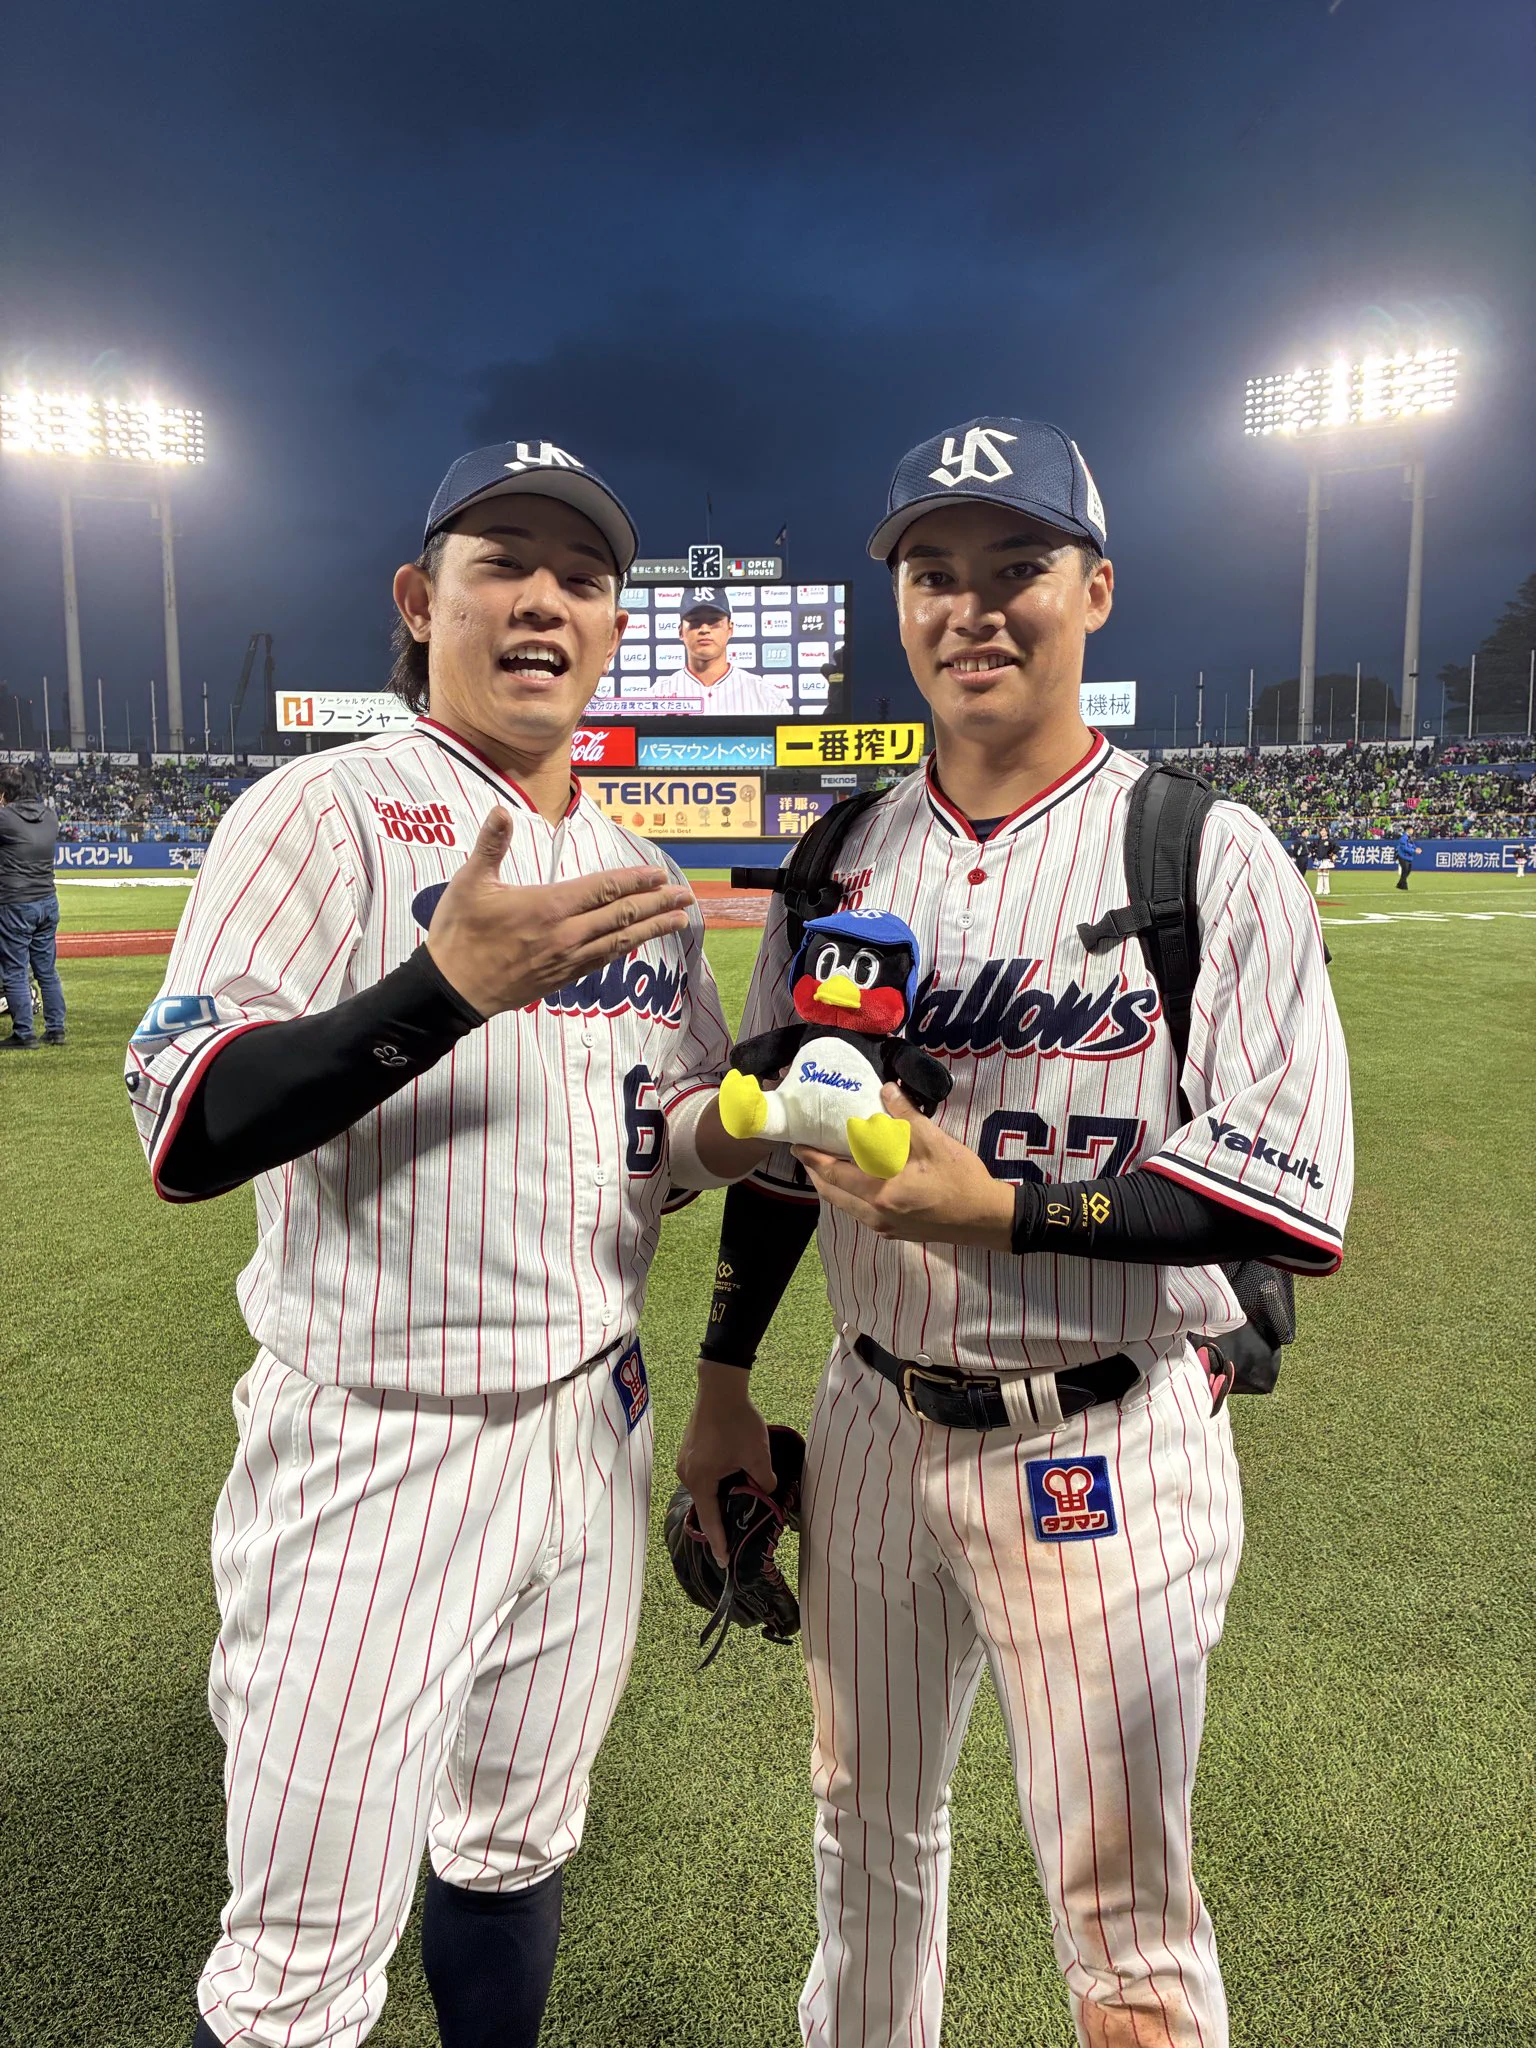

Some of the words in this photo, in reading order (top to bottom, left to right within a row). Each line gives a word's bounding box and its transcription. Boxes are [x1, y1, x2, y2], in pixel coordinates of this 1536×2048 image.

[748, 560, 775, 569] OPEN
[658, 622, 677, 630] UAC
[319, 707, 414, 728] フージャー
[1314, 725, 1322, 734] H
[640, 743, 773, 760] パラマウントベッド
[786, 729, 914, 761] 一番搾り
[822, 777, 857, 785] TEKNOS
[598, 782, 737, 805] TEKNOS
[779, 797, 818, 811] 洋服の
[364, 789, 455, 825] Yakult
[378, 816, 456, 847] 1000
[777, 811, 822, 834] 青山
[53, 847, 133, 865] ハイスクール
[1351, 846, 1399, 864] 協栄産
[1435, 852, 1500, 868] 国際物流
[892, 958, 1163, 1061] allows
[799, 1061, 862, 1092] Swallows
[978, 1110, 1147, 1186] 67
[1207, 1116, 1324, 1190] Yakult
[711, 1302, 727, 1324] 67
[1044, 1512, 1105, 1532] タフマン
